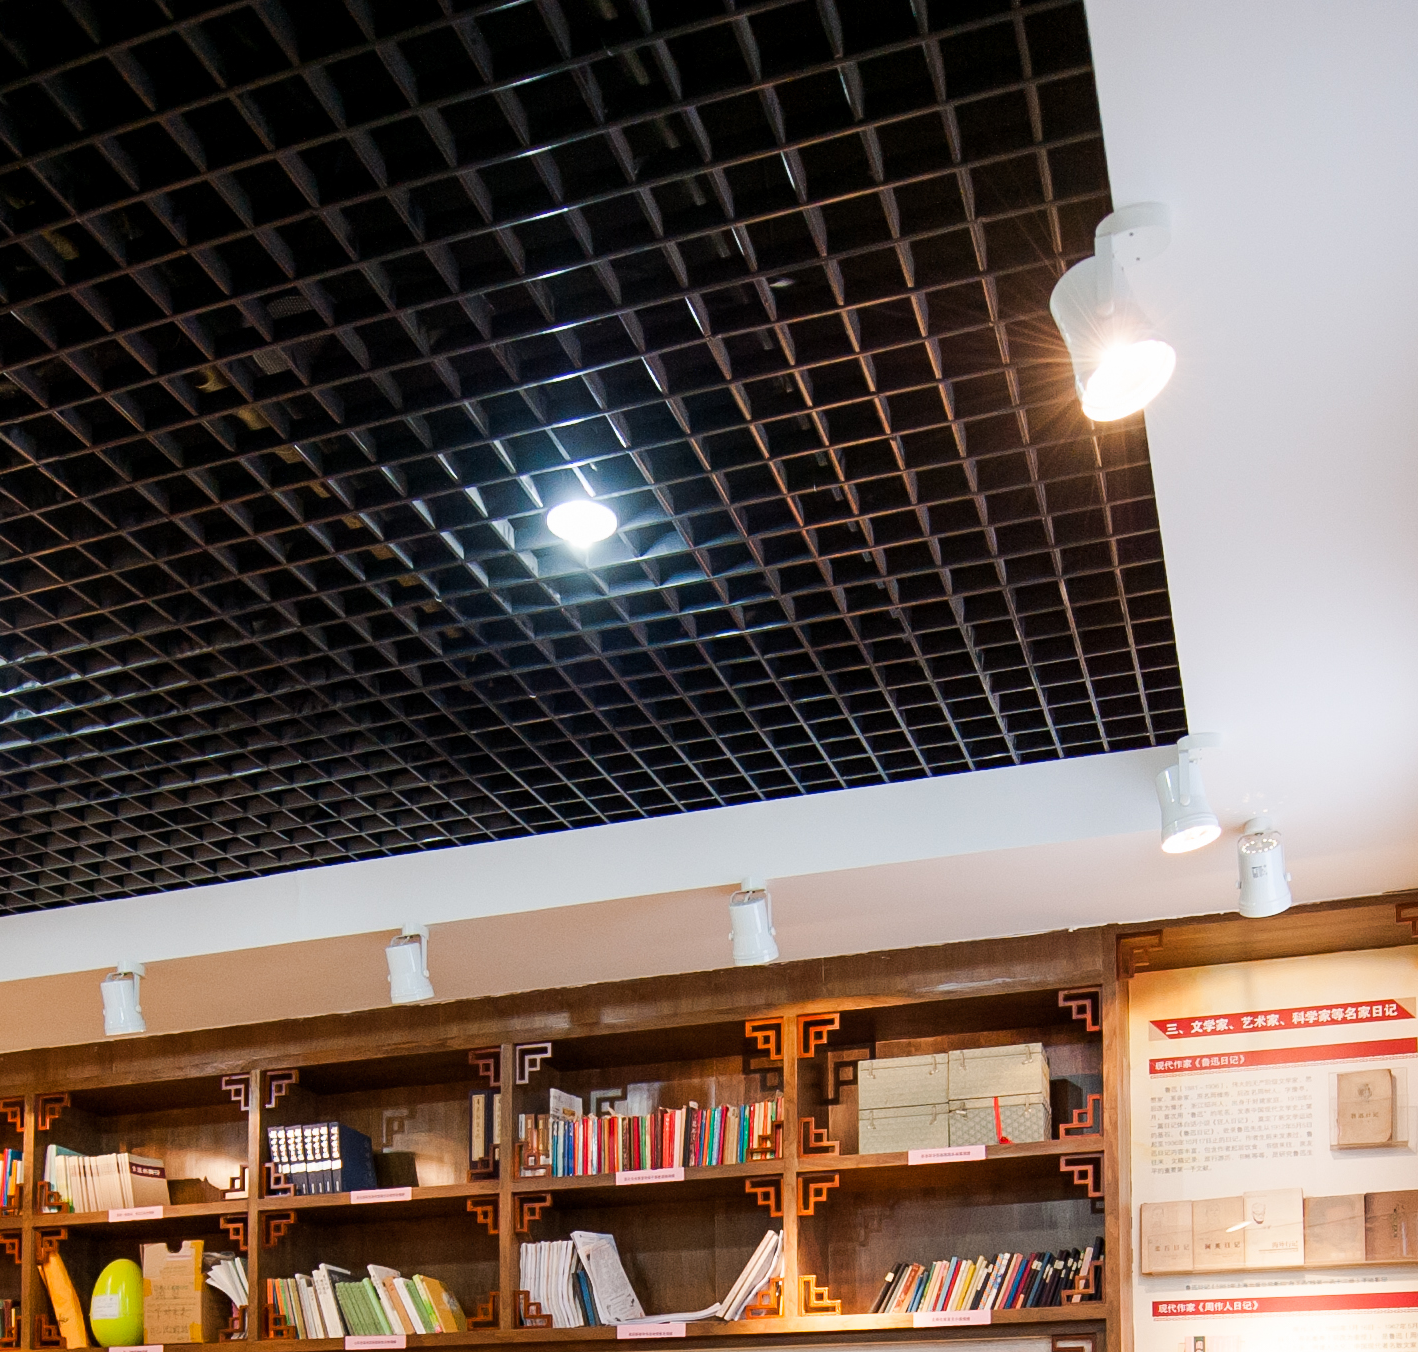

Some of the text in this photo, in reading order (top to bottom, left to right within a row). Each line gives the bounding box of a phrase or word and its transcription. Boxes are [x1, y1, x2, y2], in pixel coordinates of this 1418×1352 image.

[1165, 1004, 1399, 1036] 三、文学家、艺术家、科学家等名家日记
[1154, 1054, 1246, 1071] 现代作家《鲁迅日记》
[1158, 1301, 1260, 1314] 现代作家《周作人日记》
